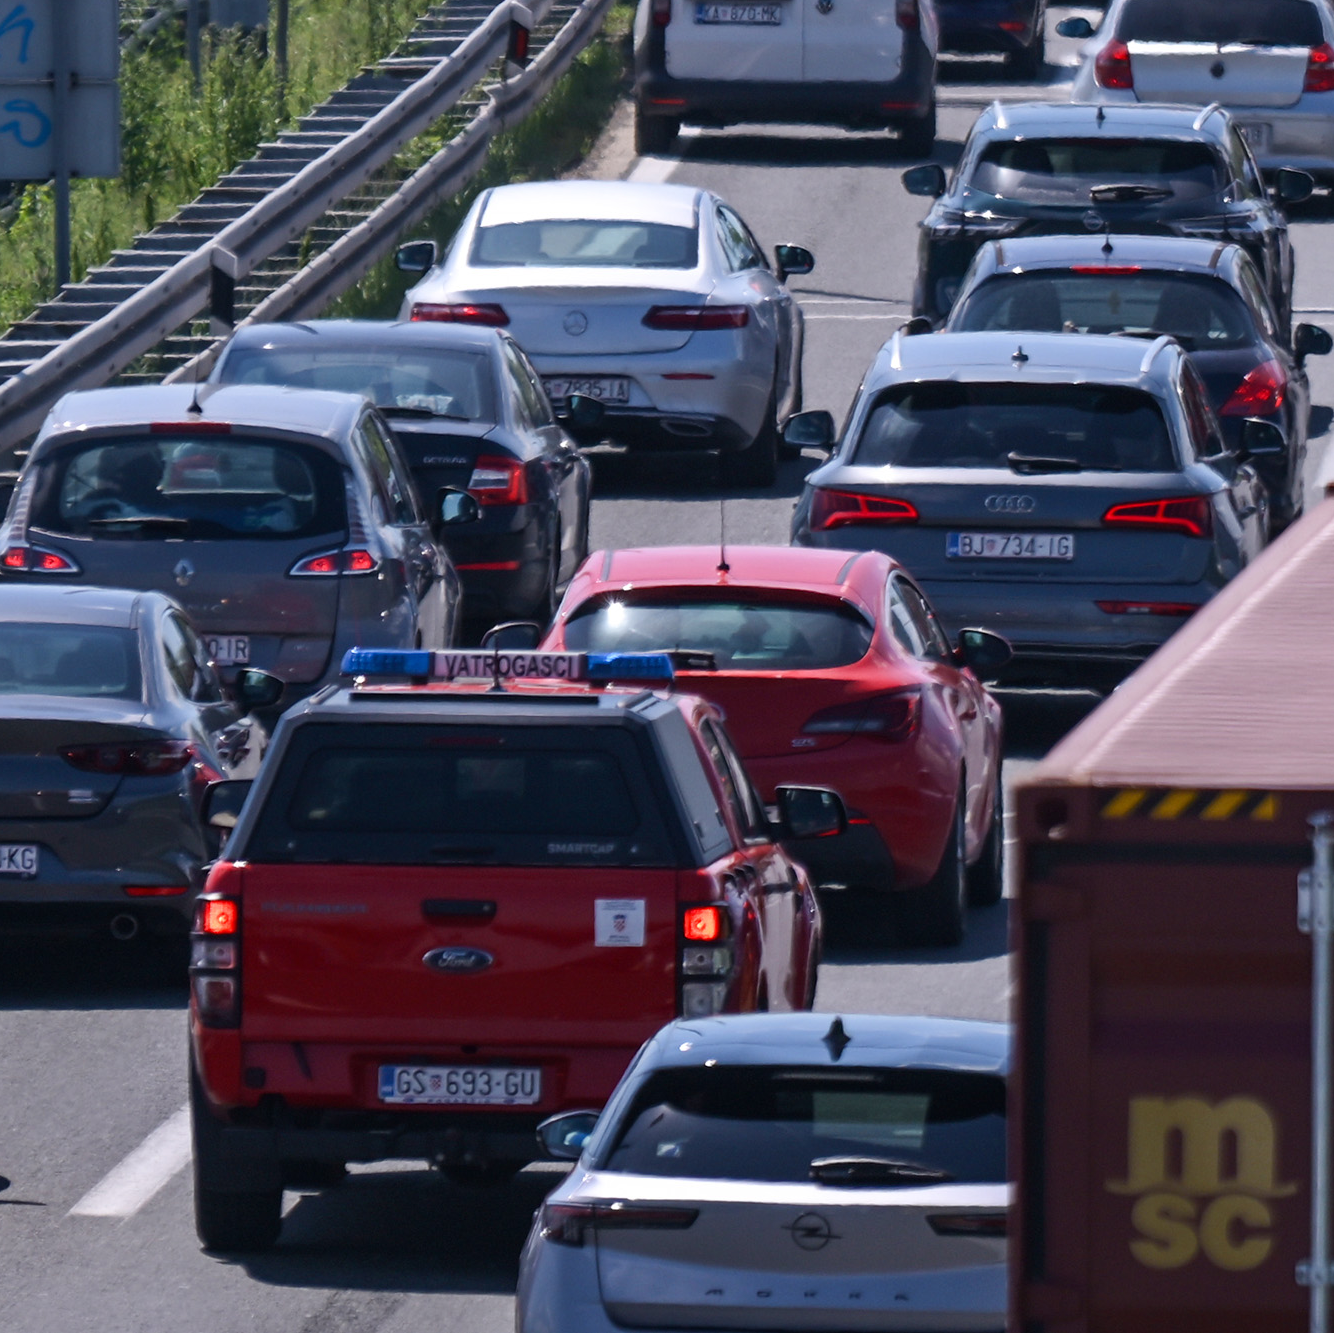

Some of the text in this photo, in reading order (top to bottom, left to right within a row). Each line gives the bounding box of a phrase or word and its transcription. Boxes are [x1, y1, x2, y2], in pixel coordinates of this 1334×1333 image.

[961, 535, 1069, 557] BJ 734-IG
[444, 654, 574, 679] VATROGASCI
[396, 1069, 536, 1097] GS 693-GU
